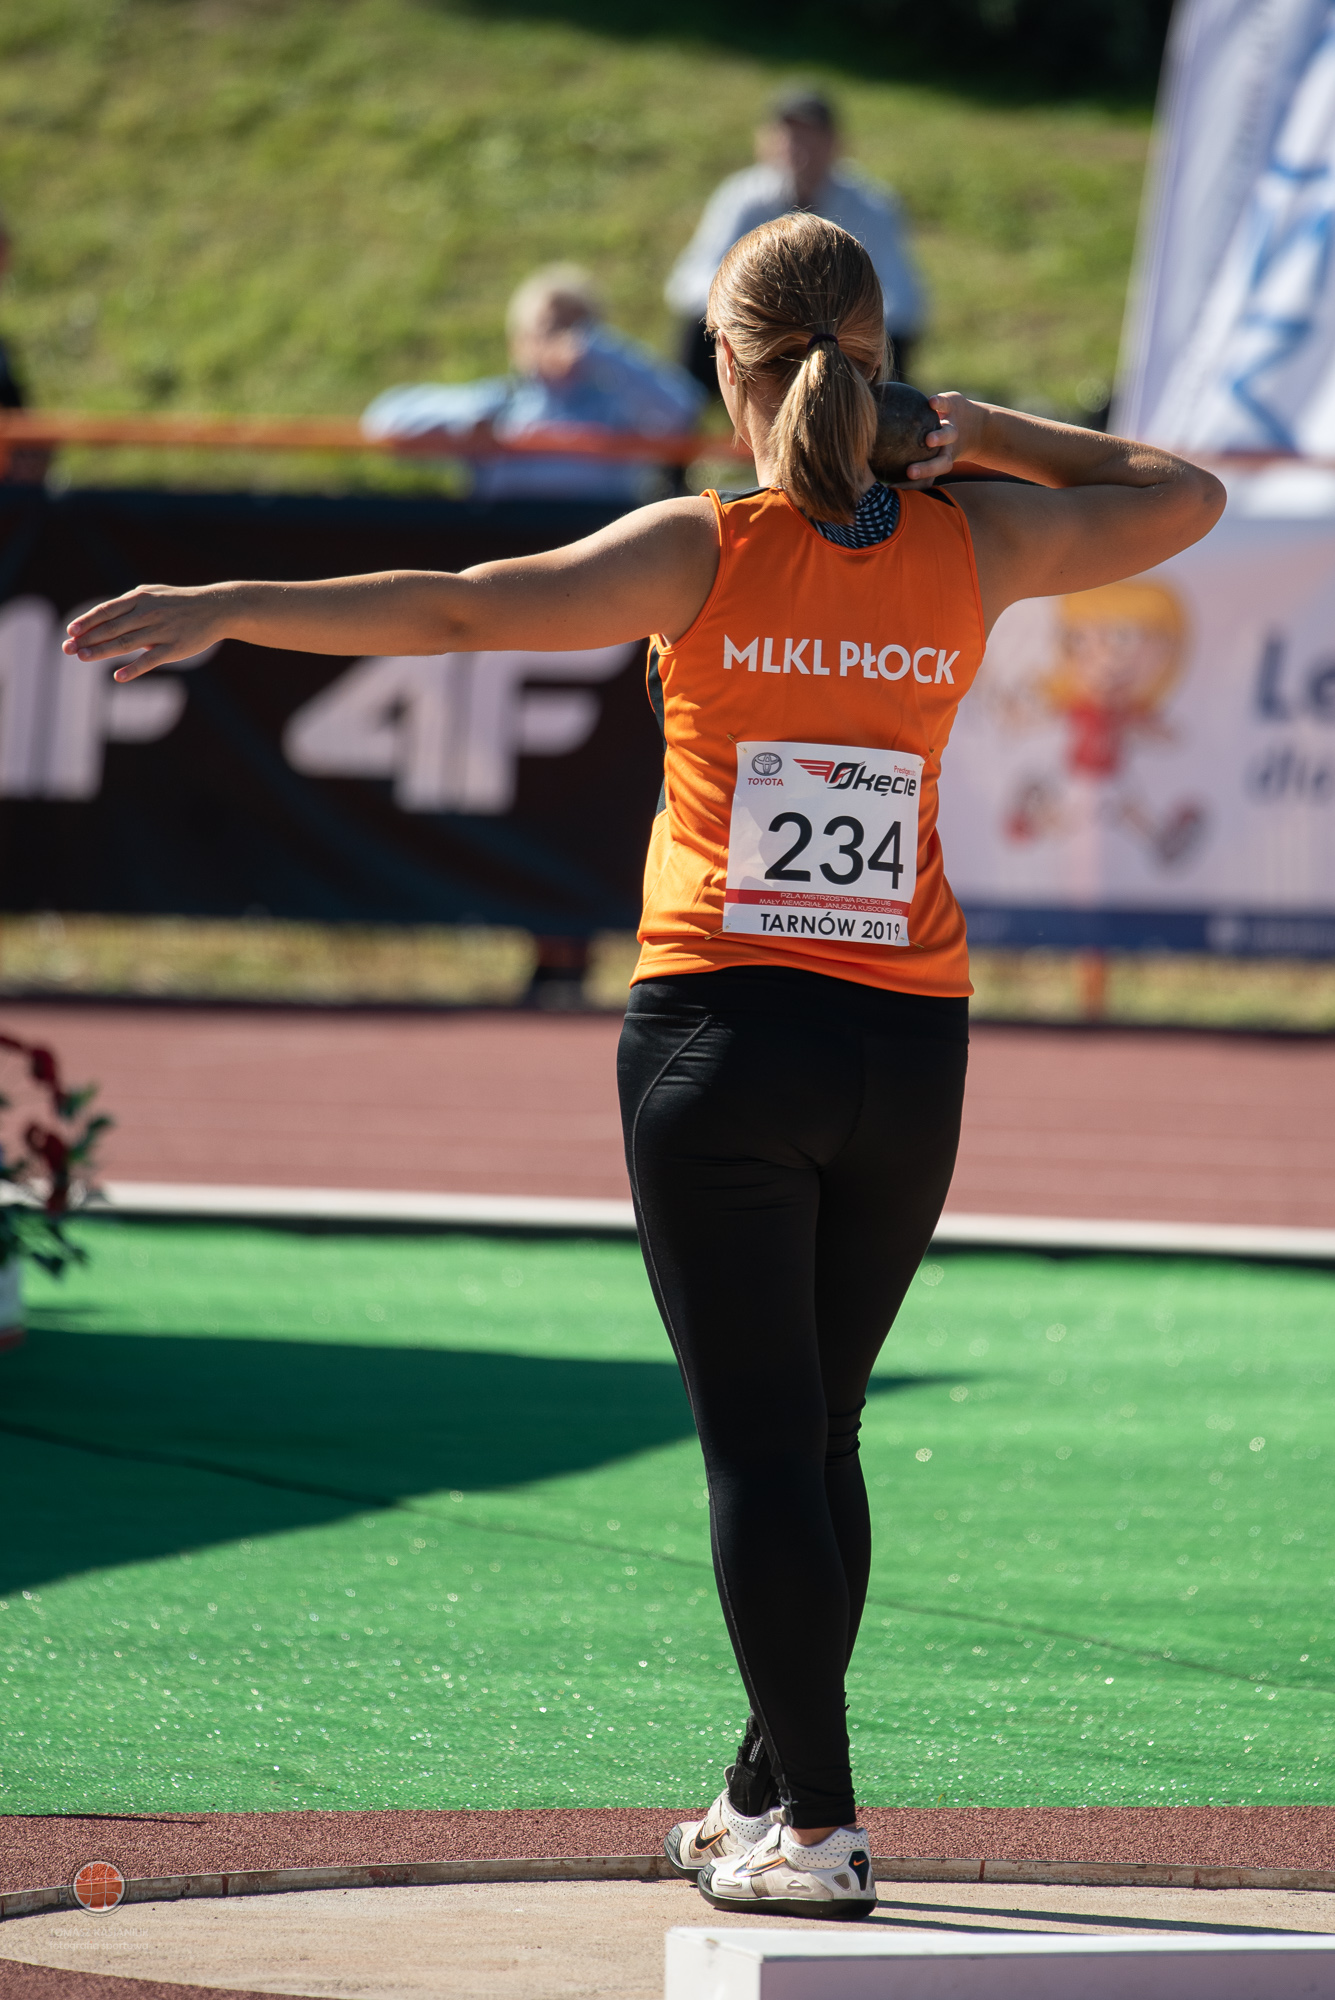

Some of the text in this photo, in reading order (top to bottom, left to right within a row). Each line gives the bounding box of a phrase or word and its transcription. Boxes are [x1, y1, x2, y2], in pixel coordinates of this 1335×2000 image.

[723, 634, 961, 685] MLKL PŁOCK
[282, 648, 642, 815] 4F
[747, 777, 785, 787] TOYOTA
[763, 811, 904, 890] 234
[759, 898, 780, 906] MAŁY
[781, 899, 822, 908] MEMORIAŁ
[823, 901, 858, 911] JANUSZA
[780, 892, 801, 900] PZLA
[801, 893, 856, 904] MISTRZOSTWA
[855, 897, 881, 906] POLSKI
[760, 911, 901, 941] TARNÓW 2019
